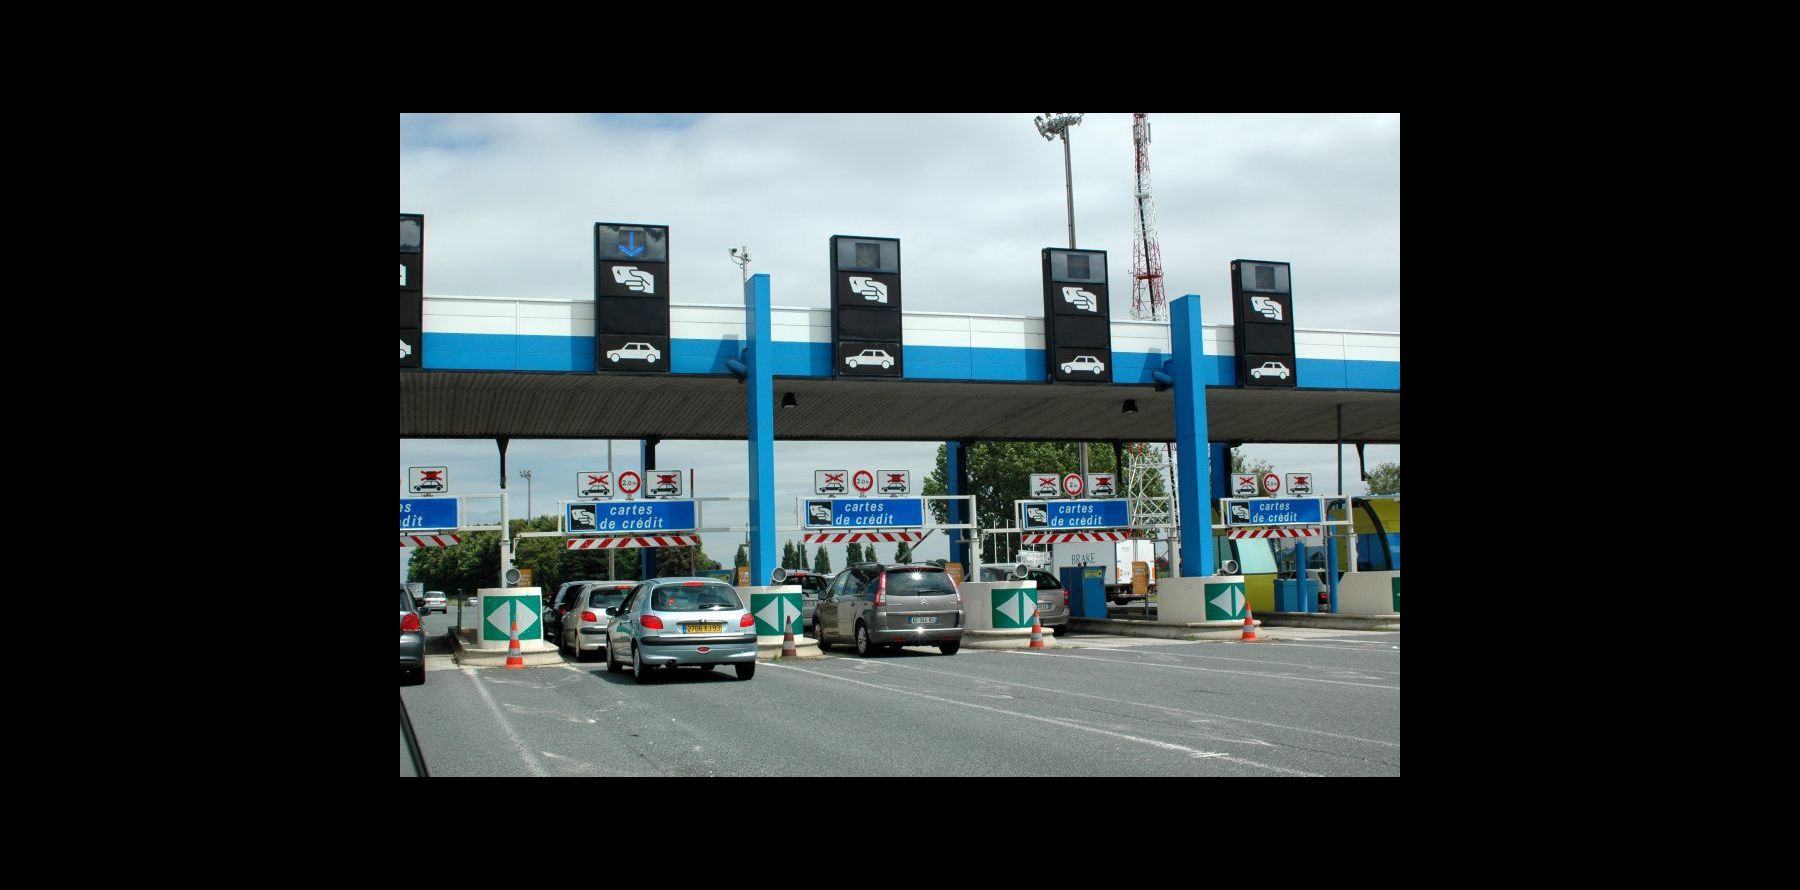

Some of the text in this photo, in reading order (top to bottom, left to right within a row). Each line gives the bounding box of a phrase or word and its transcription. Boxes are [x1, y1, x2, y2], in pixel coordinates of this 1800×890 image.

[609, 505, 653, 516] cartes
[844, 502, 884, 512] cartes
[1058, 504, 1094, 514] cartes
[1259, 502, 1290, 511] cartes
[399, 514, 423, 527] dit
[599, 516, 664, 530] de crédit
[835, 513, 894, 525] de crédit
[1051, 515, 1103, 527] de crédit
[1252, 512, 1298, 523] de crédit
[1071, 552, 1096, 565] BRAKE
